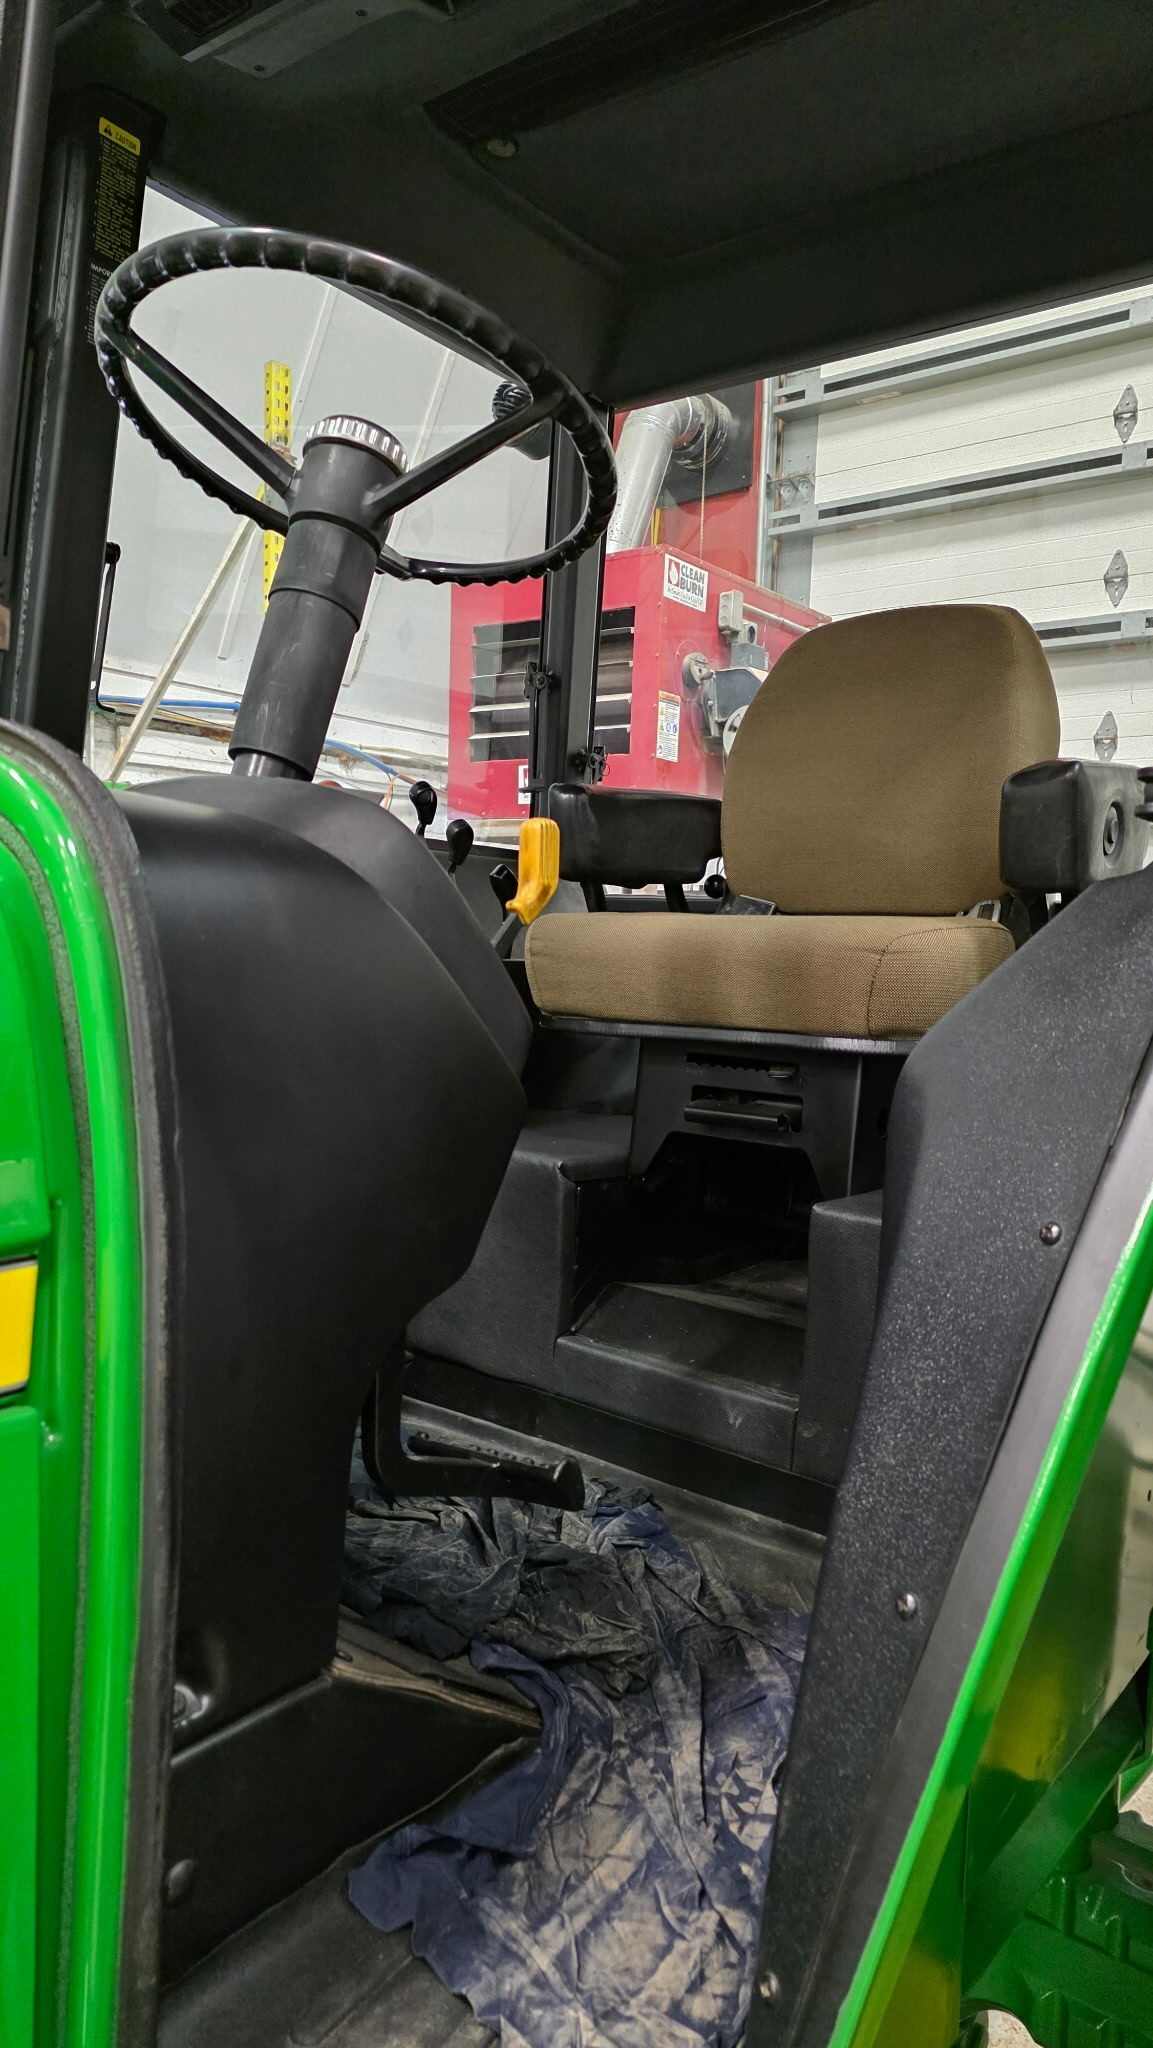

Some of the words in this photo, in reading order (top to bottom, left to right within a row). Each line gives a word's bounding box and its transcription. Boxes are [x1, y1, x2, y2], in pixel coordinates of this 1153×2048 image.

[115, 132, 137, 151] CAUTION
[91, 262, 113, 277] IMPOR
[681, 564, 705, 585] CLEAN
[680, 576, 704, 598] BURN
